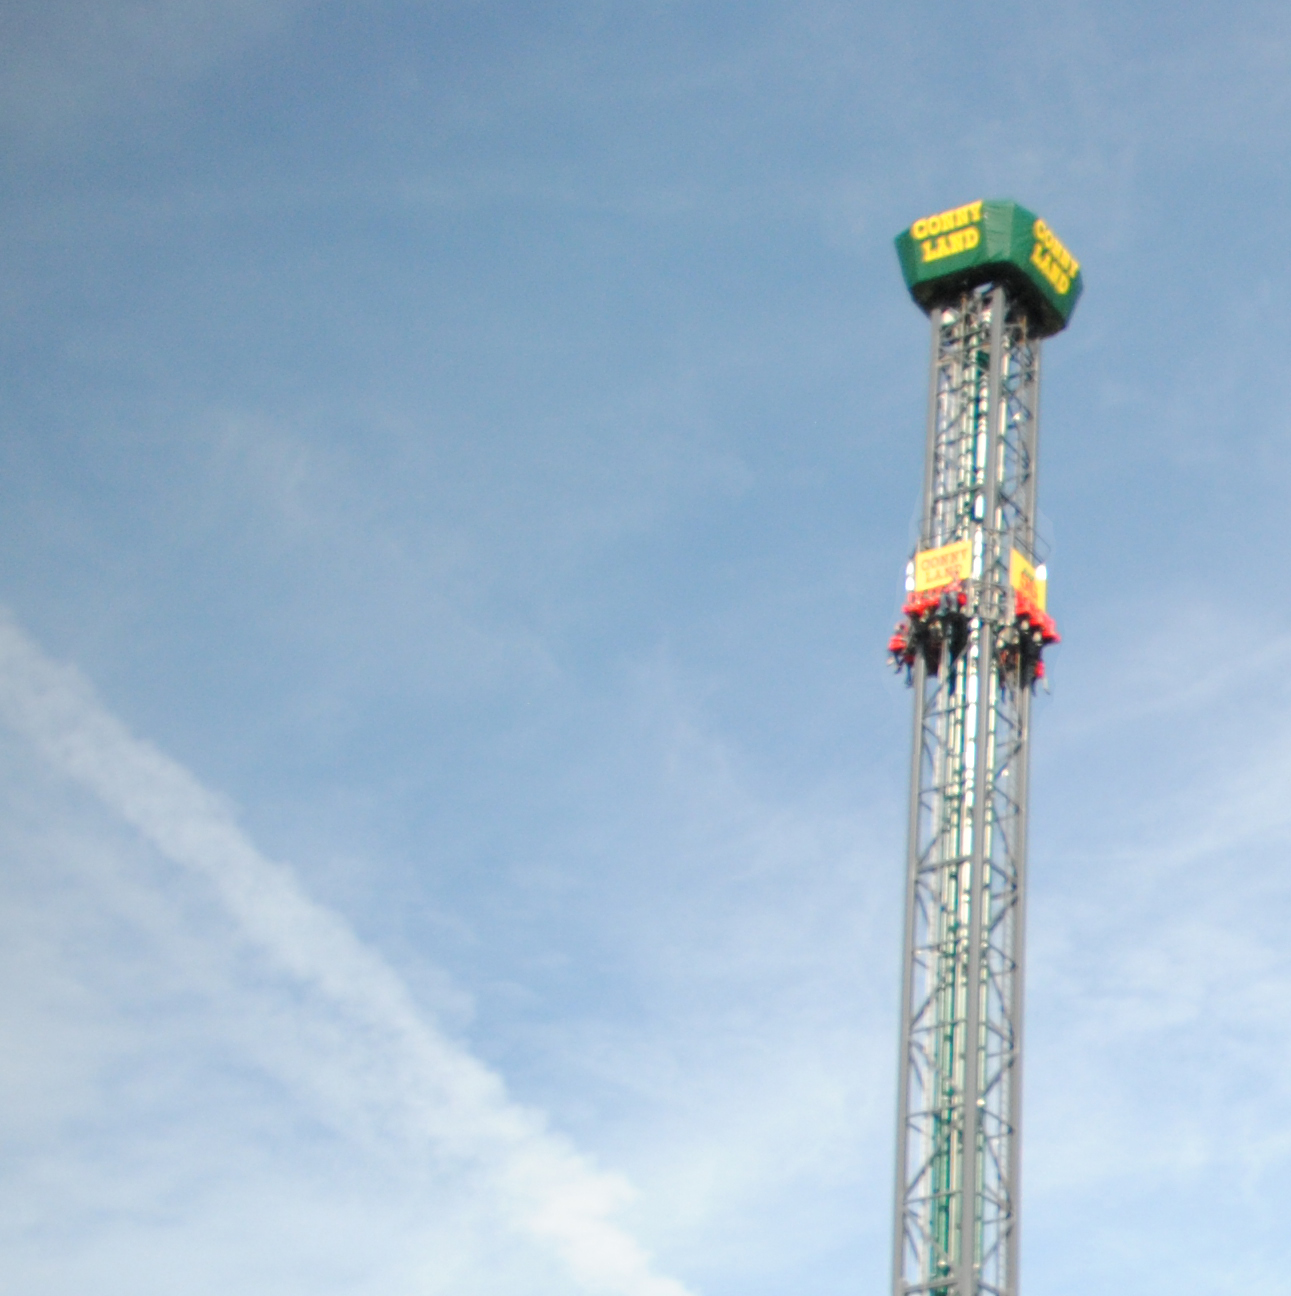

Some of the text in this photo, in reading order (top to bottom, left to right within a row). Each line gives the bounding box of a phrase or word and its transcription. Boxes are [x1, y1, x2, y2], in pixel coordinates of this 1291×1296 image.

[910, 199, 983, 241] CONNY
[920, 226, 981, 264] LAND
[1029, 241, 1072, 295] LAND
[1033, 217, 1081, 279] CONNY
